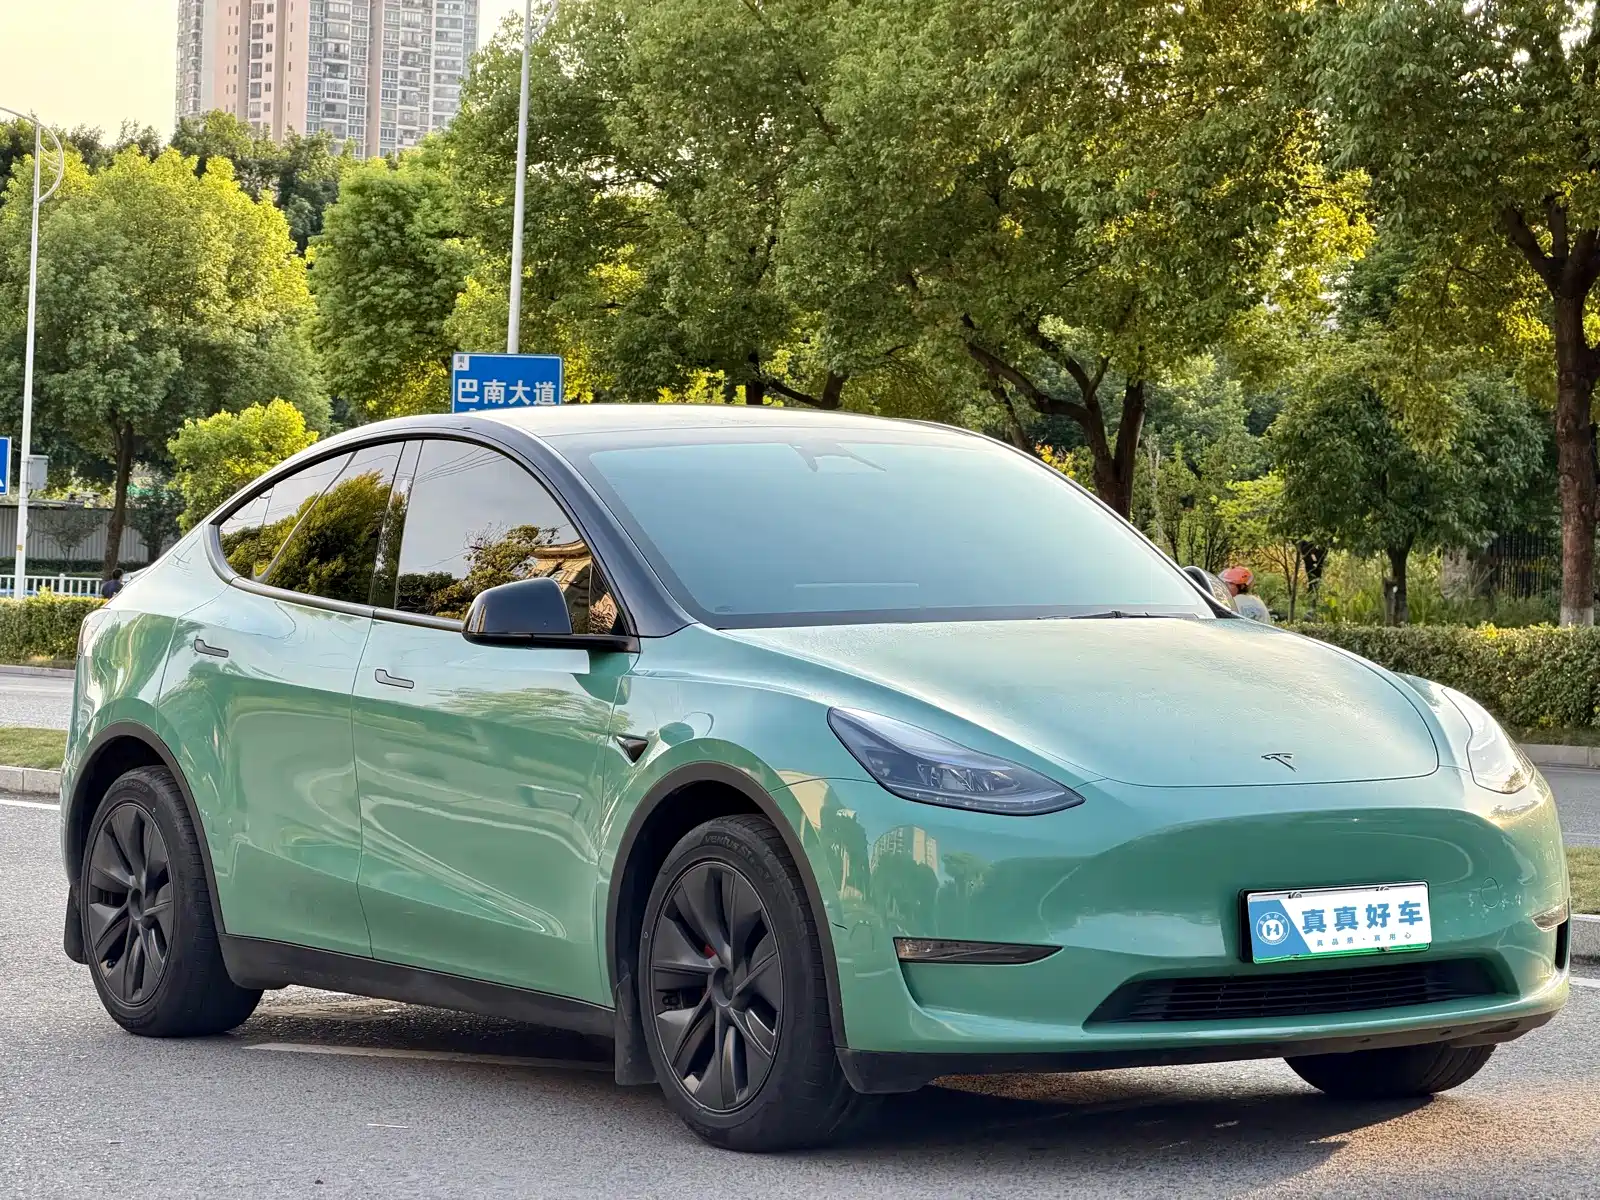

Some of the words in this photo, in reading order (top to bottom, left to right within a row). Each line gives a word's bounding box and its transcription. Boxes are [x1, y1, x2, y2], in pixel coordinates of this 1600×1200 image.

[457, 379, 556, 405] 巴南大道
[1302, 901, 1423, 934] 真真好车
